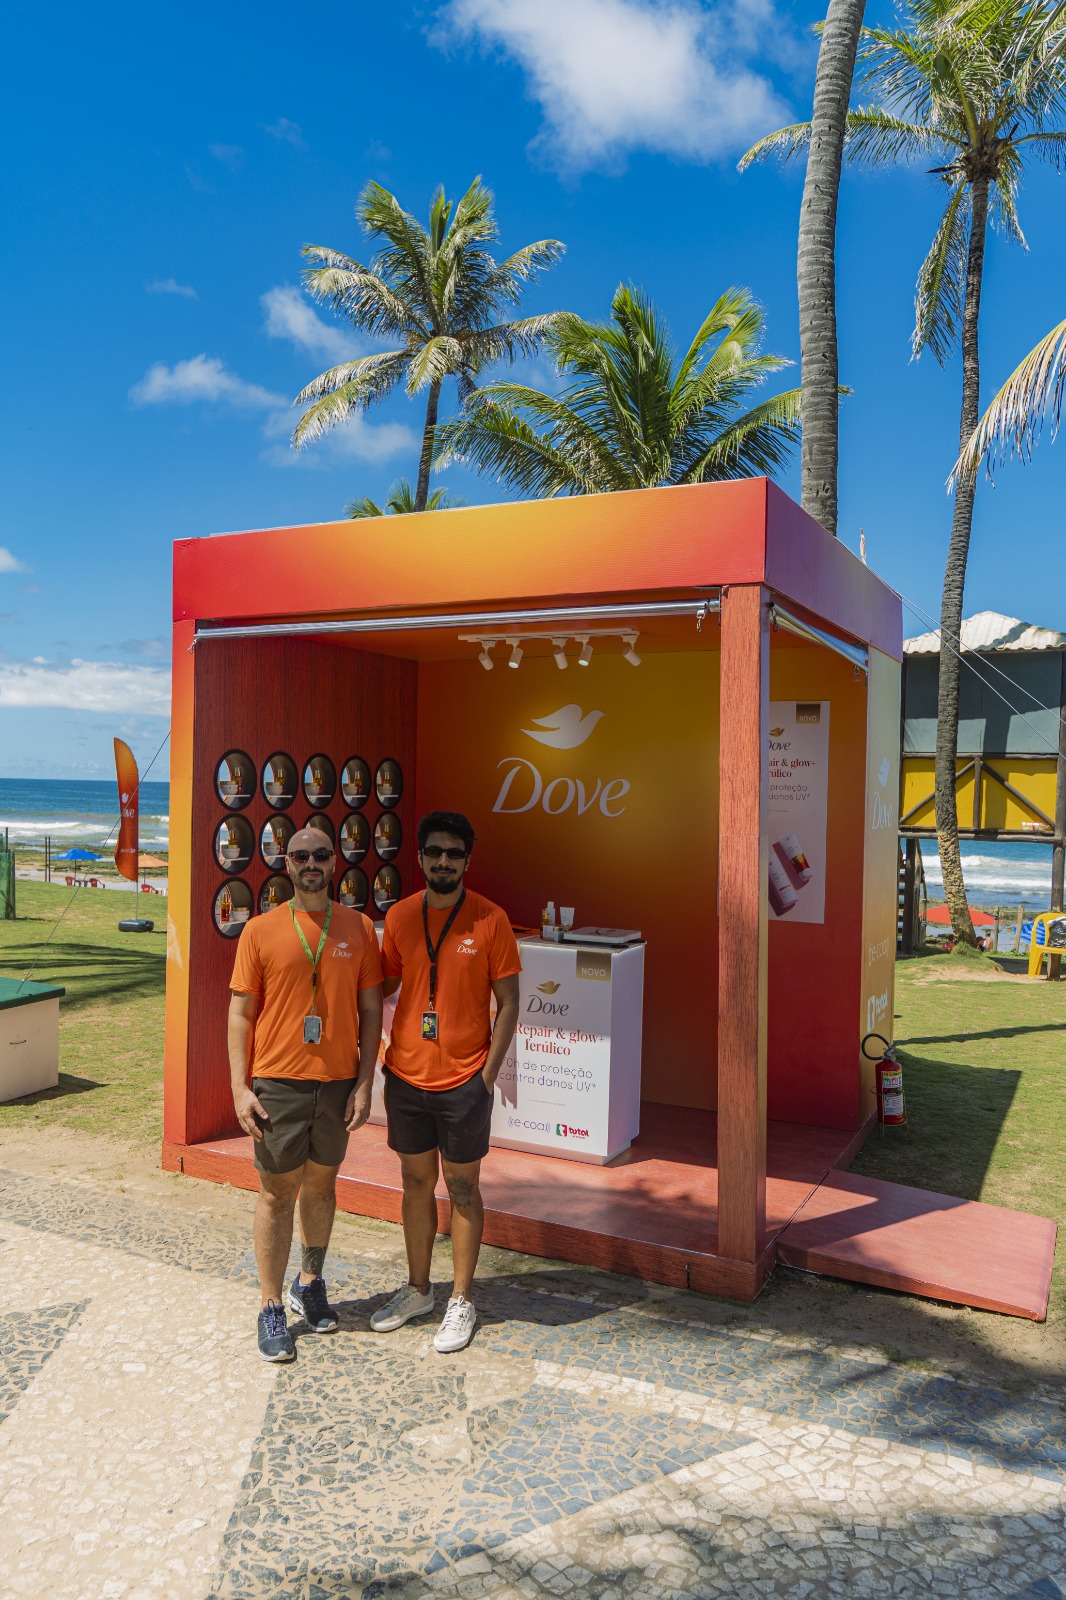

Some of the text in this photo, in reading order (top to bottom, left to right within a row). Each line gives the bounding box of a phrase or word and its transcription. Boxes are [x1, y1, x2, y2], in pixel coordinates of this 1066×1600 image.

[781, 758, 788, 767] &
[790, 758, 816, 769] glow+
[491, 757, 631, 817] Dove
[770, 784, 808, 792] proteção
[872, 791, 893, 829] Dove
[332, 947, 353, 958] Dove
[456, 944, 478, 955] Dove
[581, 967, 607, 977] NOVO
[526, 994, 569, 1017] Dove
[515, 1023, 605, 1044] Repair & glow+
[525, 1038, 571, 1056] ferúlico
[522, 1060, 538, 1071] de
[540, 1064, 593, 1079] proteção
[499, 1072, 535, 1084] contra
[537, 1076, 573, 1090] danos
